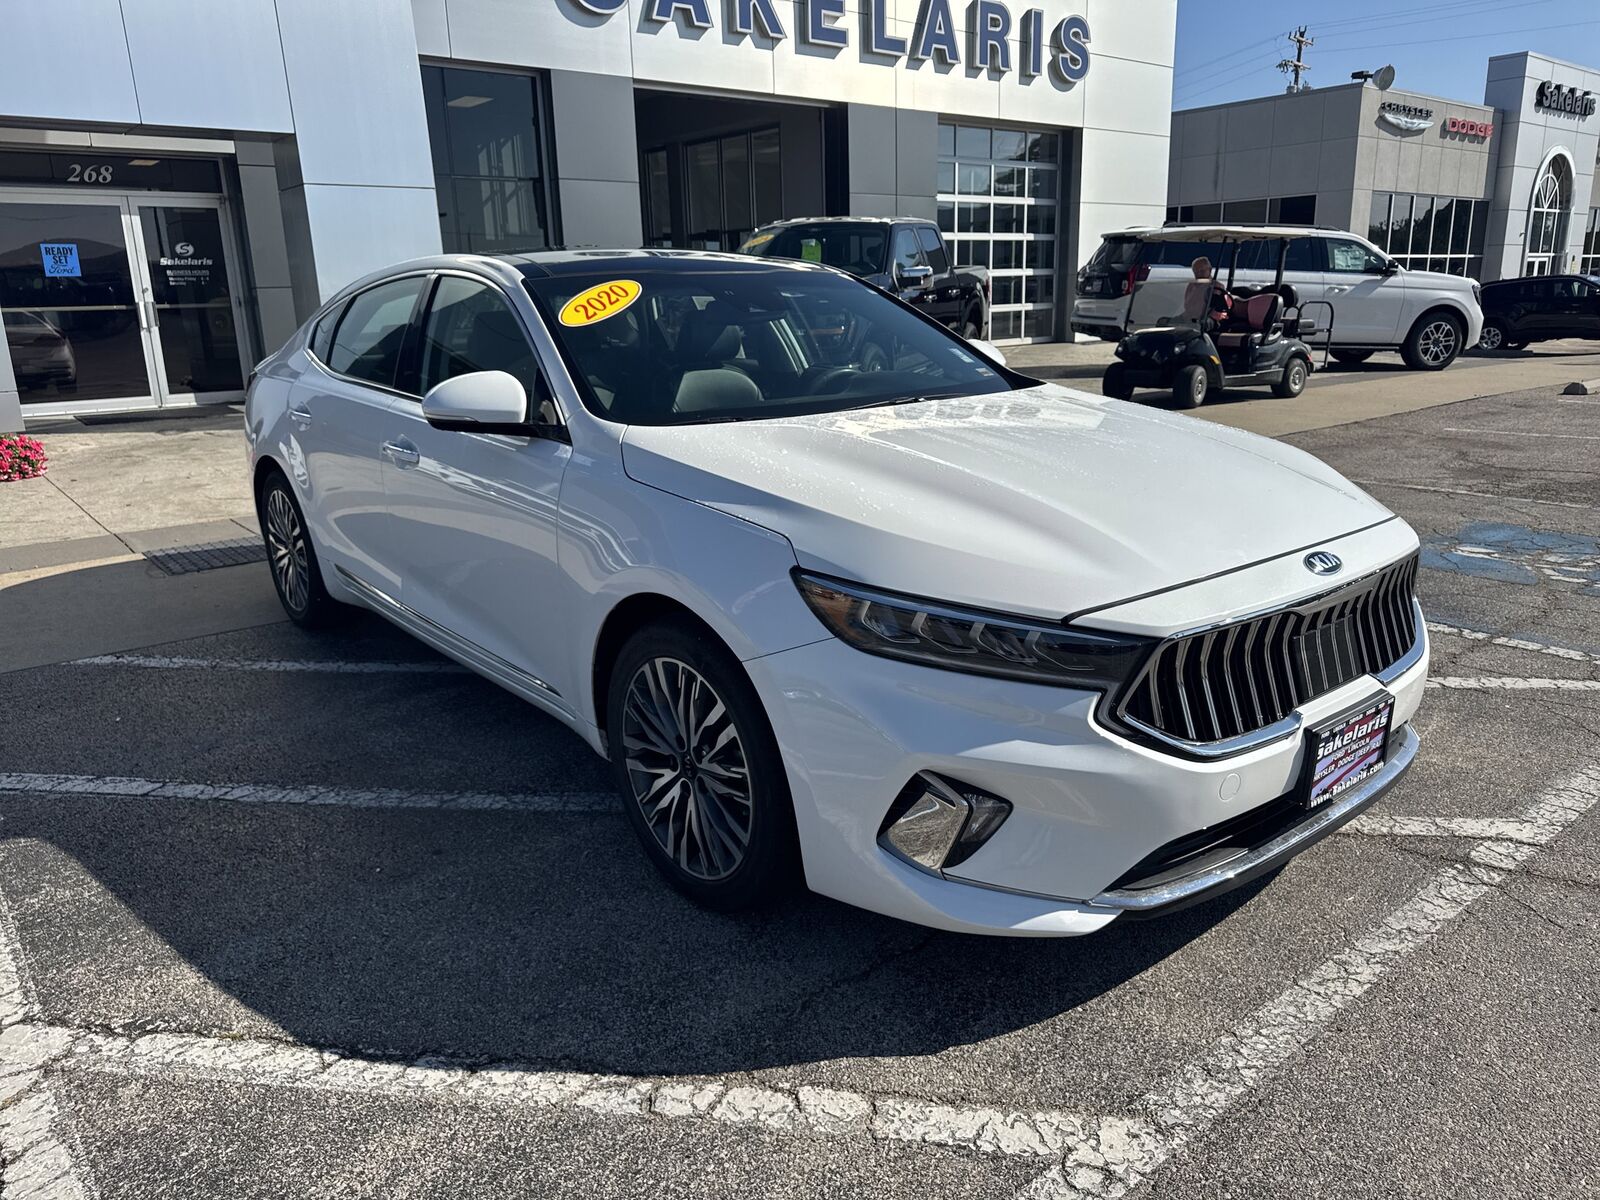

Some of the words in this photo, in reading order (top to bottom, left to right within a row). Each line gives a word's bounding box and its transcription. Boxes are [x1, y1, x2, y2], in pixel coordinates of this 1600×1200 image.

[574, 0, 1092, 83] ELARIS
[1536, 80, 1597, 116] Sakelaris
[1448, 117, 1494, 137] DODGE
[67, 164, 113, 183] 268
[44, 246, 73, 256] READY
[53, 255, 69, 265] SET
[49, 264, 75, 274] Ford
[160, 257, 213, 266] Sakelaris
[574, 285, 629, 320] 2020
[1309, 553, 1340, 571] KIA
[1317, 713, 1388, 760] Sakelaris
[1313, 764, 1336, 781] HRYSLER
